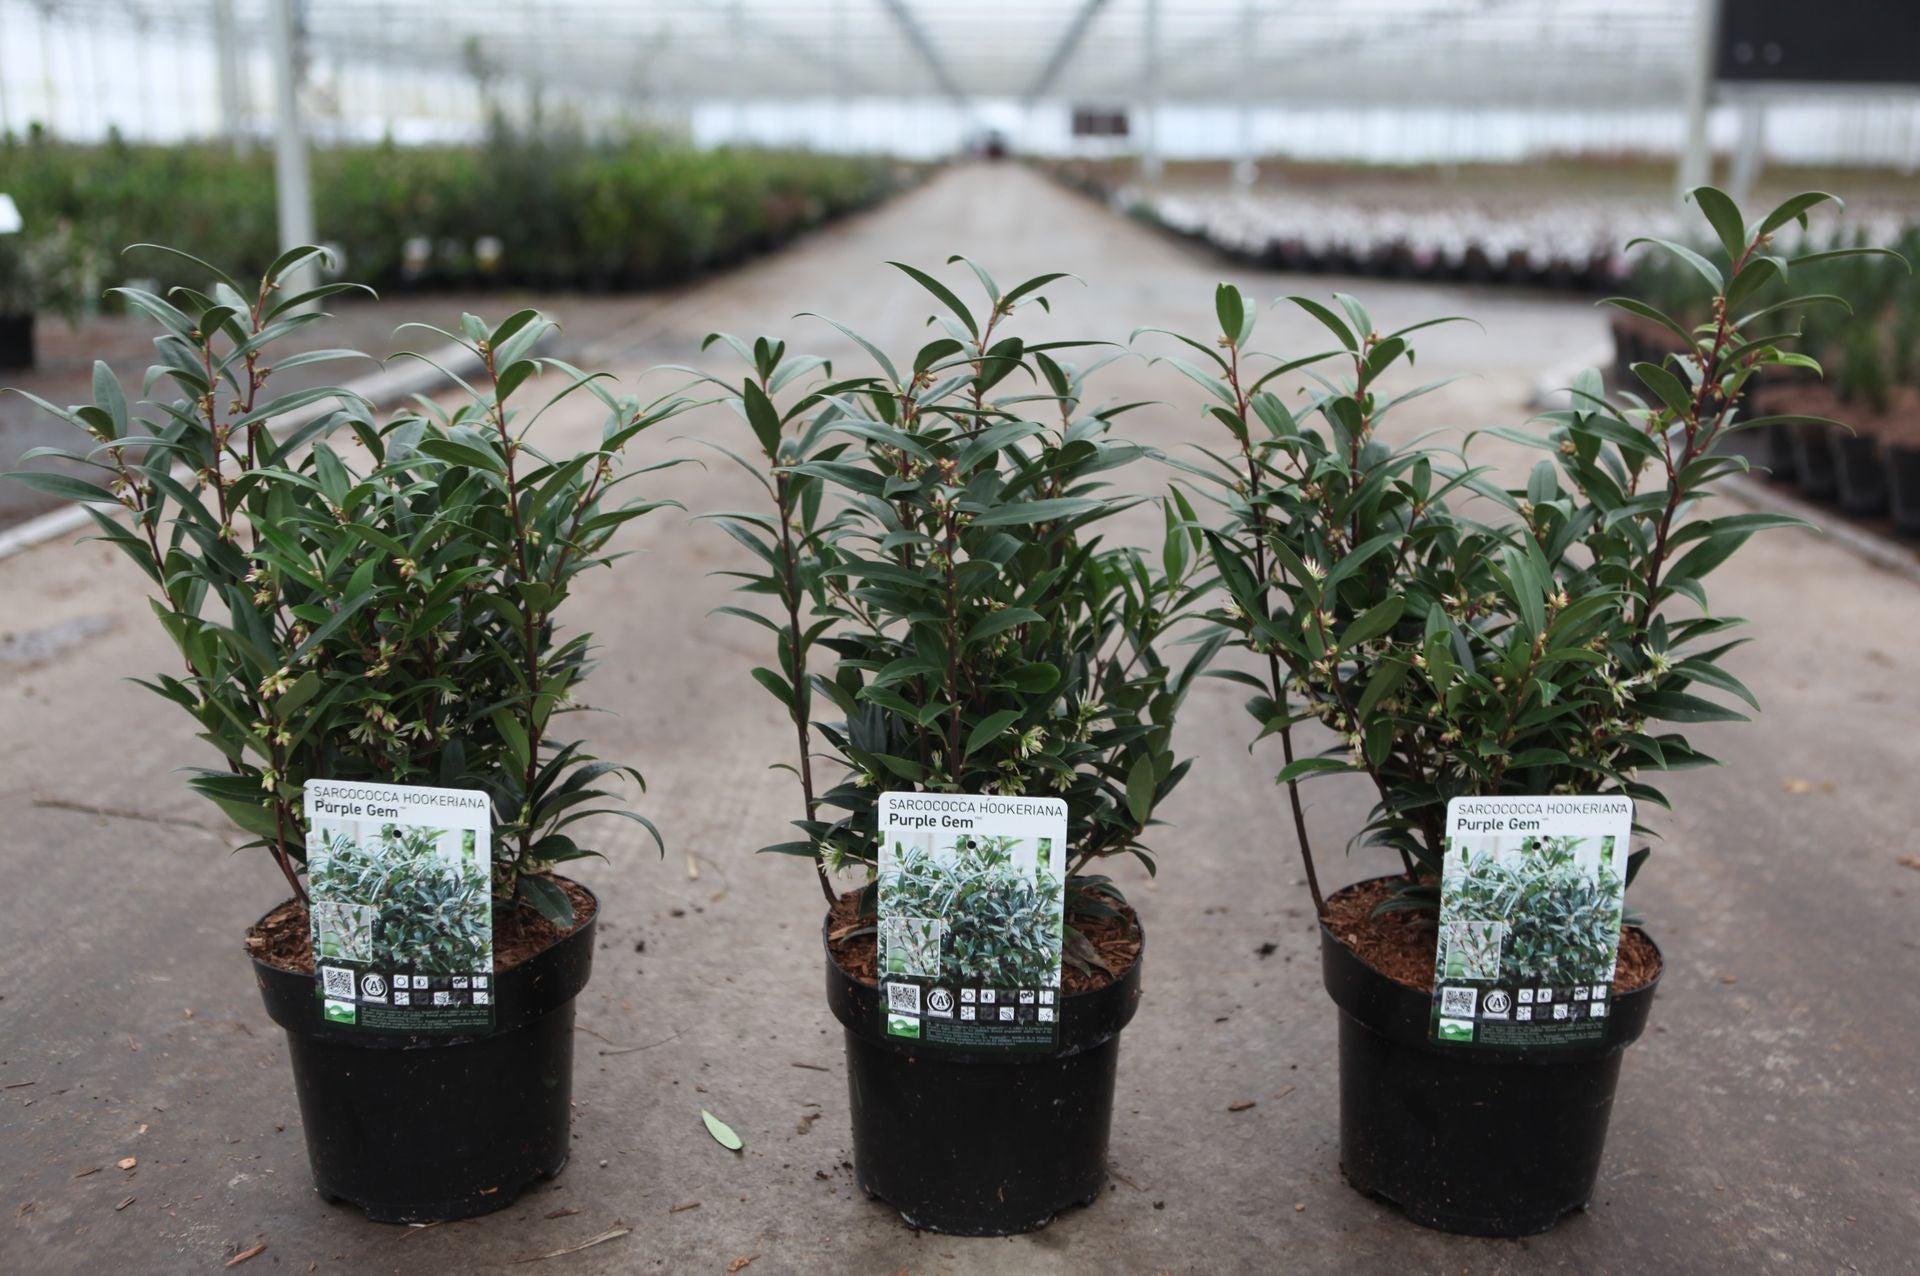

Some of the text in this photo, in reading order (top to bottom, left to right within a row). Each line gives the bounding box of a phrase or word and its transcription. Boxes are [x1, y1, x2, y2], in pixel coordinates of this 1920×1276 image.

[314, 786, 485, 809] SARCOCOCCA HOOKERIANA
[315, 800, 398, 818] Purple Gem
[889, 799, 1063, 816] SARCOCOCCA HOOKERIANA
[1458, 803, 1628, 815] SARCOCOCCA HOOKERIANA
[889, 813, 973, 829] Purple Gem
[1457, 818, 1540, 833] Purple Gem
